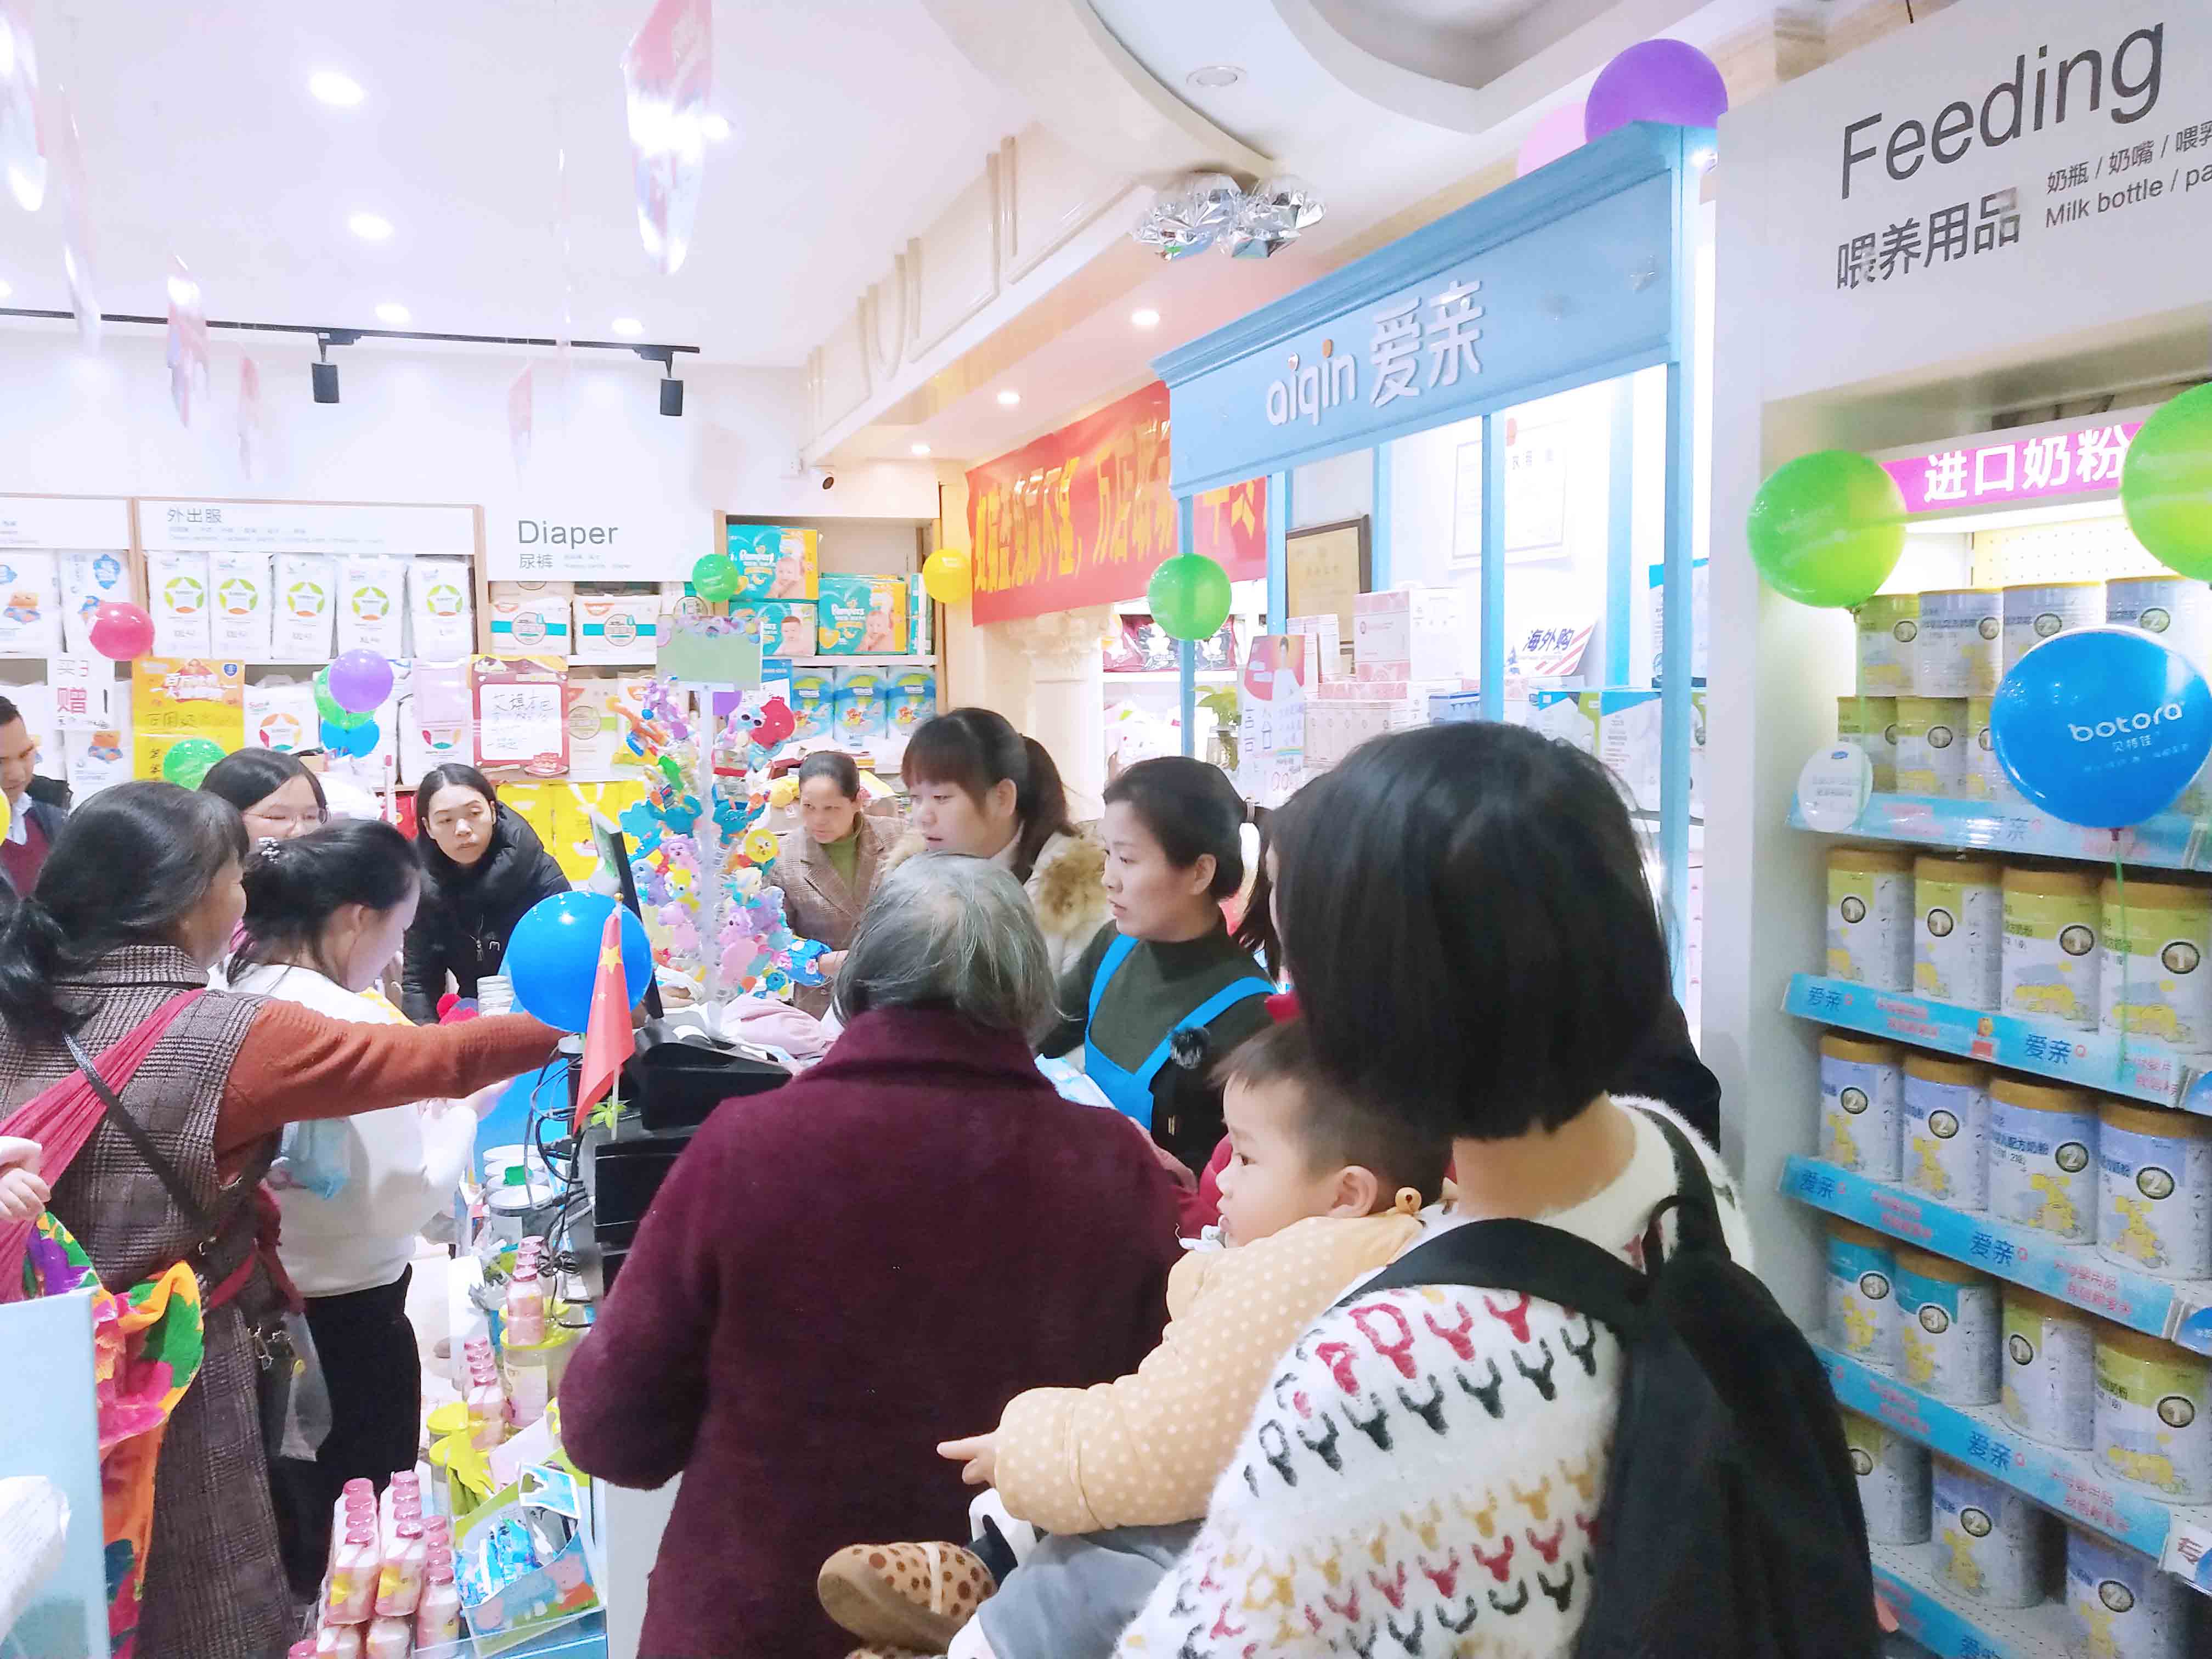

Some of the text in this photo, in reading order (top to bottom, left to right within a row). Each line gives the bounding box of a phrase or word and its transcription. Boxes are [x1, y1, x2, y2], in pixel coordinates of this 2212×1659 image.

[1842, 22, 2163, 199] Feeding
[2046, 199, 2091, 228] Milk
[2097, 179, 2163, 213] bottle
[1837, 187, 2021, 290] 喂养用品
[1266, 280, 1485, 427] aiqin 爱亲
[1923, 423, 2133, 504] 进口奶粉
[167, 508, 222, 523] 外出服
[518, 520, 618, 549] Diaper
[519, 553, 553, 569] 尿裤
[1522, 628, 1576, 652] 海外购
[2068, 703, 2183, 742] botora
[2025, 1034, 2072, 1065] 爱亲
[1970, 1231, 2015, 1267] 爱亲
[1967, 1430, 2011, 1471] 爱亲
